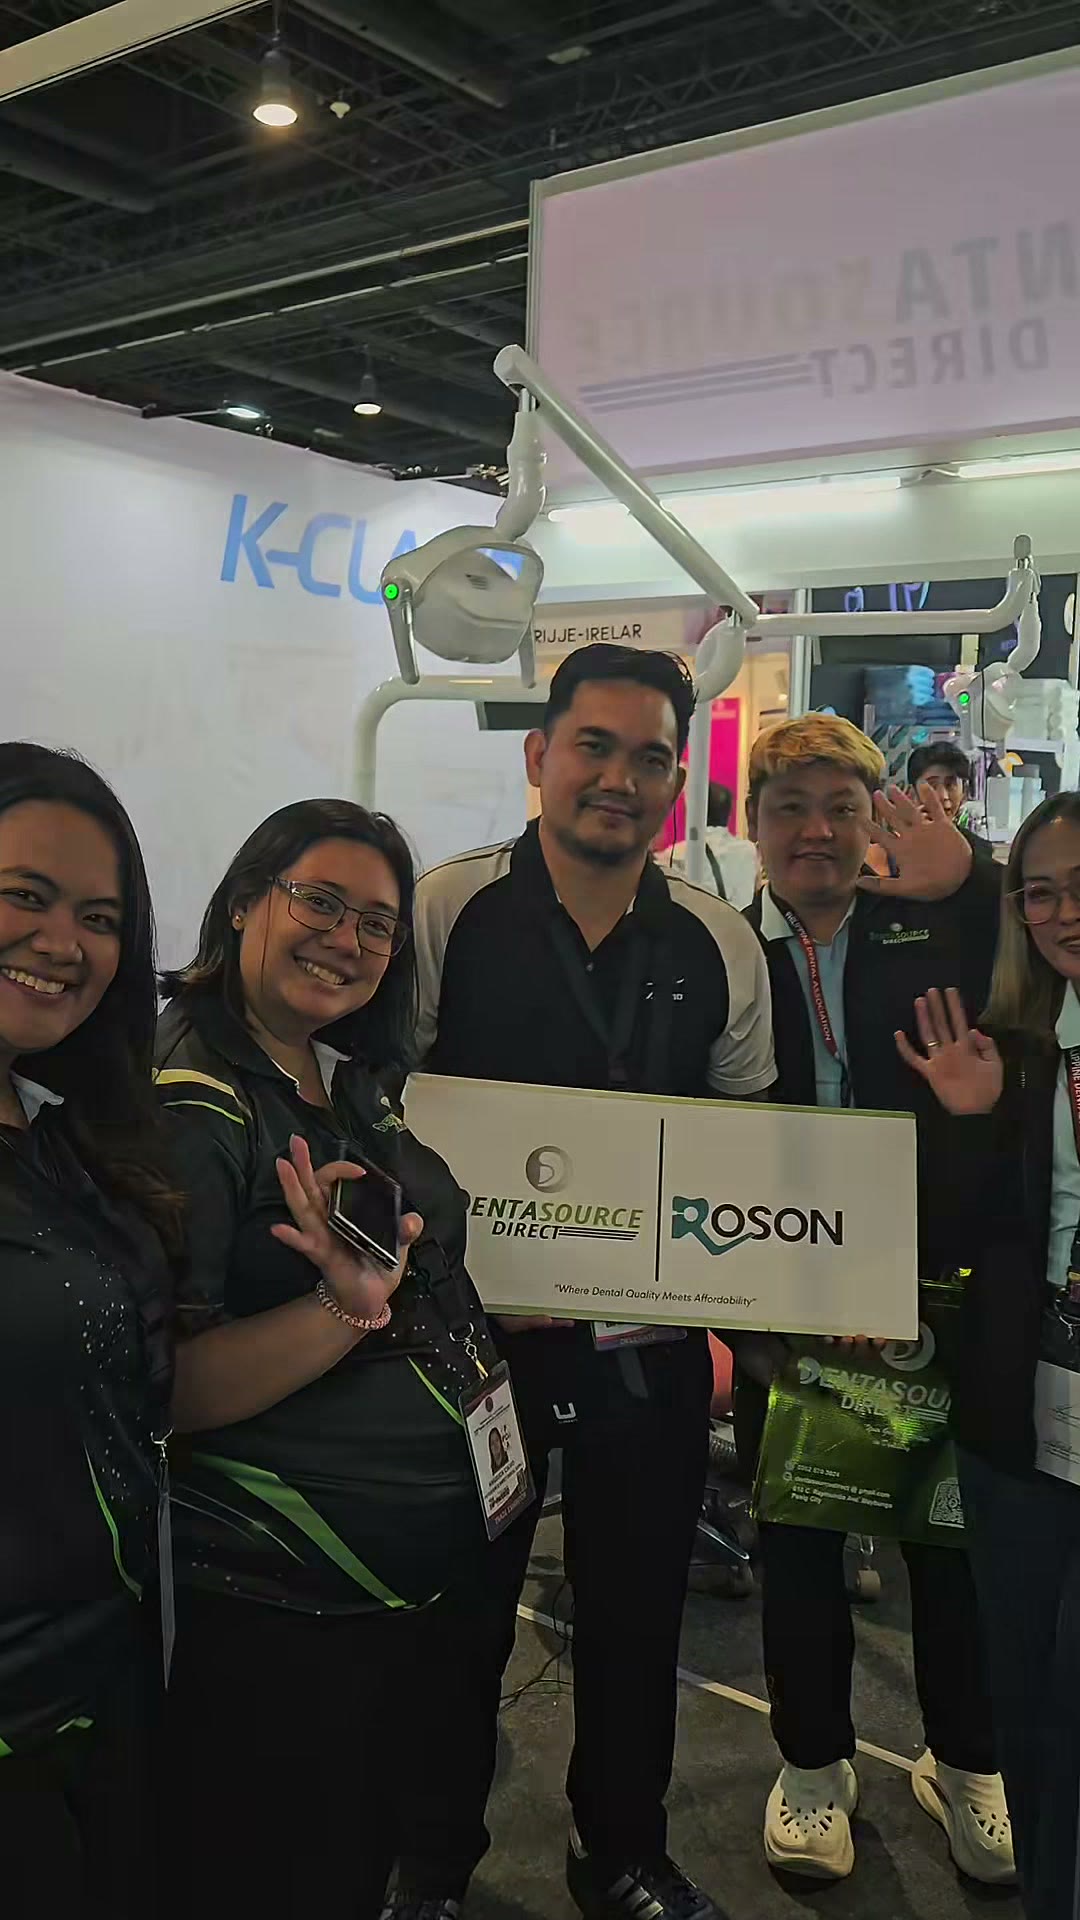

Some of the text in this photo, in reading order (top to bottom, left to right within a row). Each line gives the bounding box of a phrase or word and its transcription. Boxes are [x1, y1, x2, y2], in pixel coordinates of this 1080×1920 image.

[491, 1221, 562, 1239] DIRECT
[671, 1196, 843, 1255] ROSON
[592, 1286, 623, 1298] Dental
[626, 1289, 660, 1301] Quality
[662, 1291, 692, 1302] Meets
